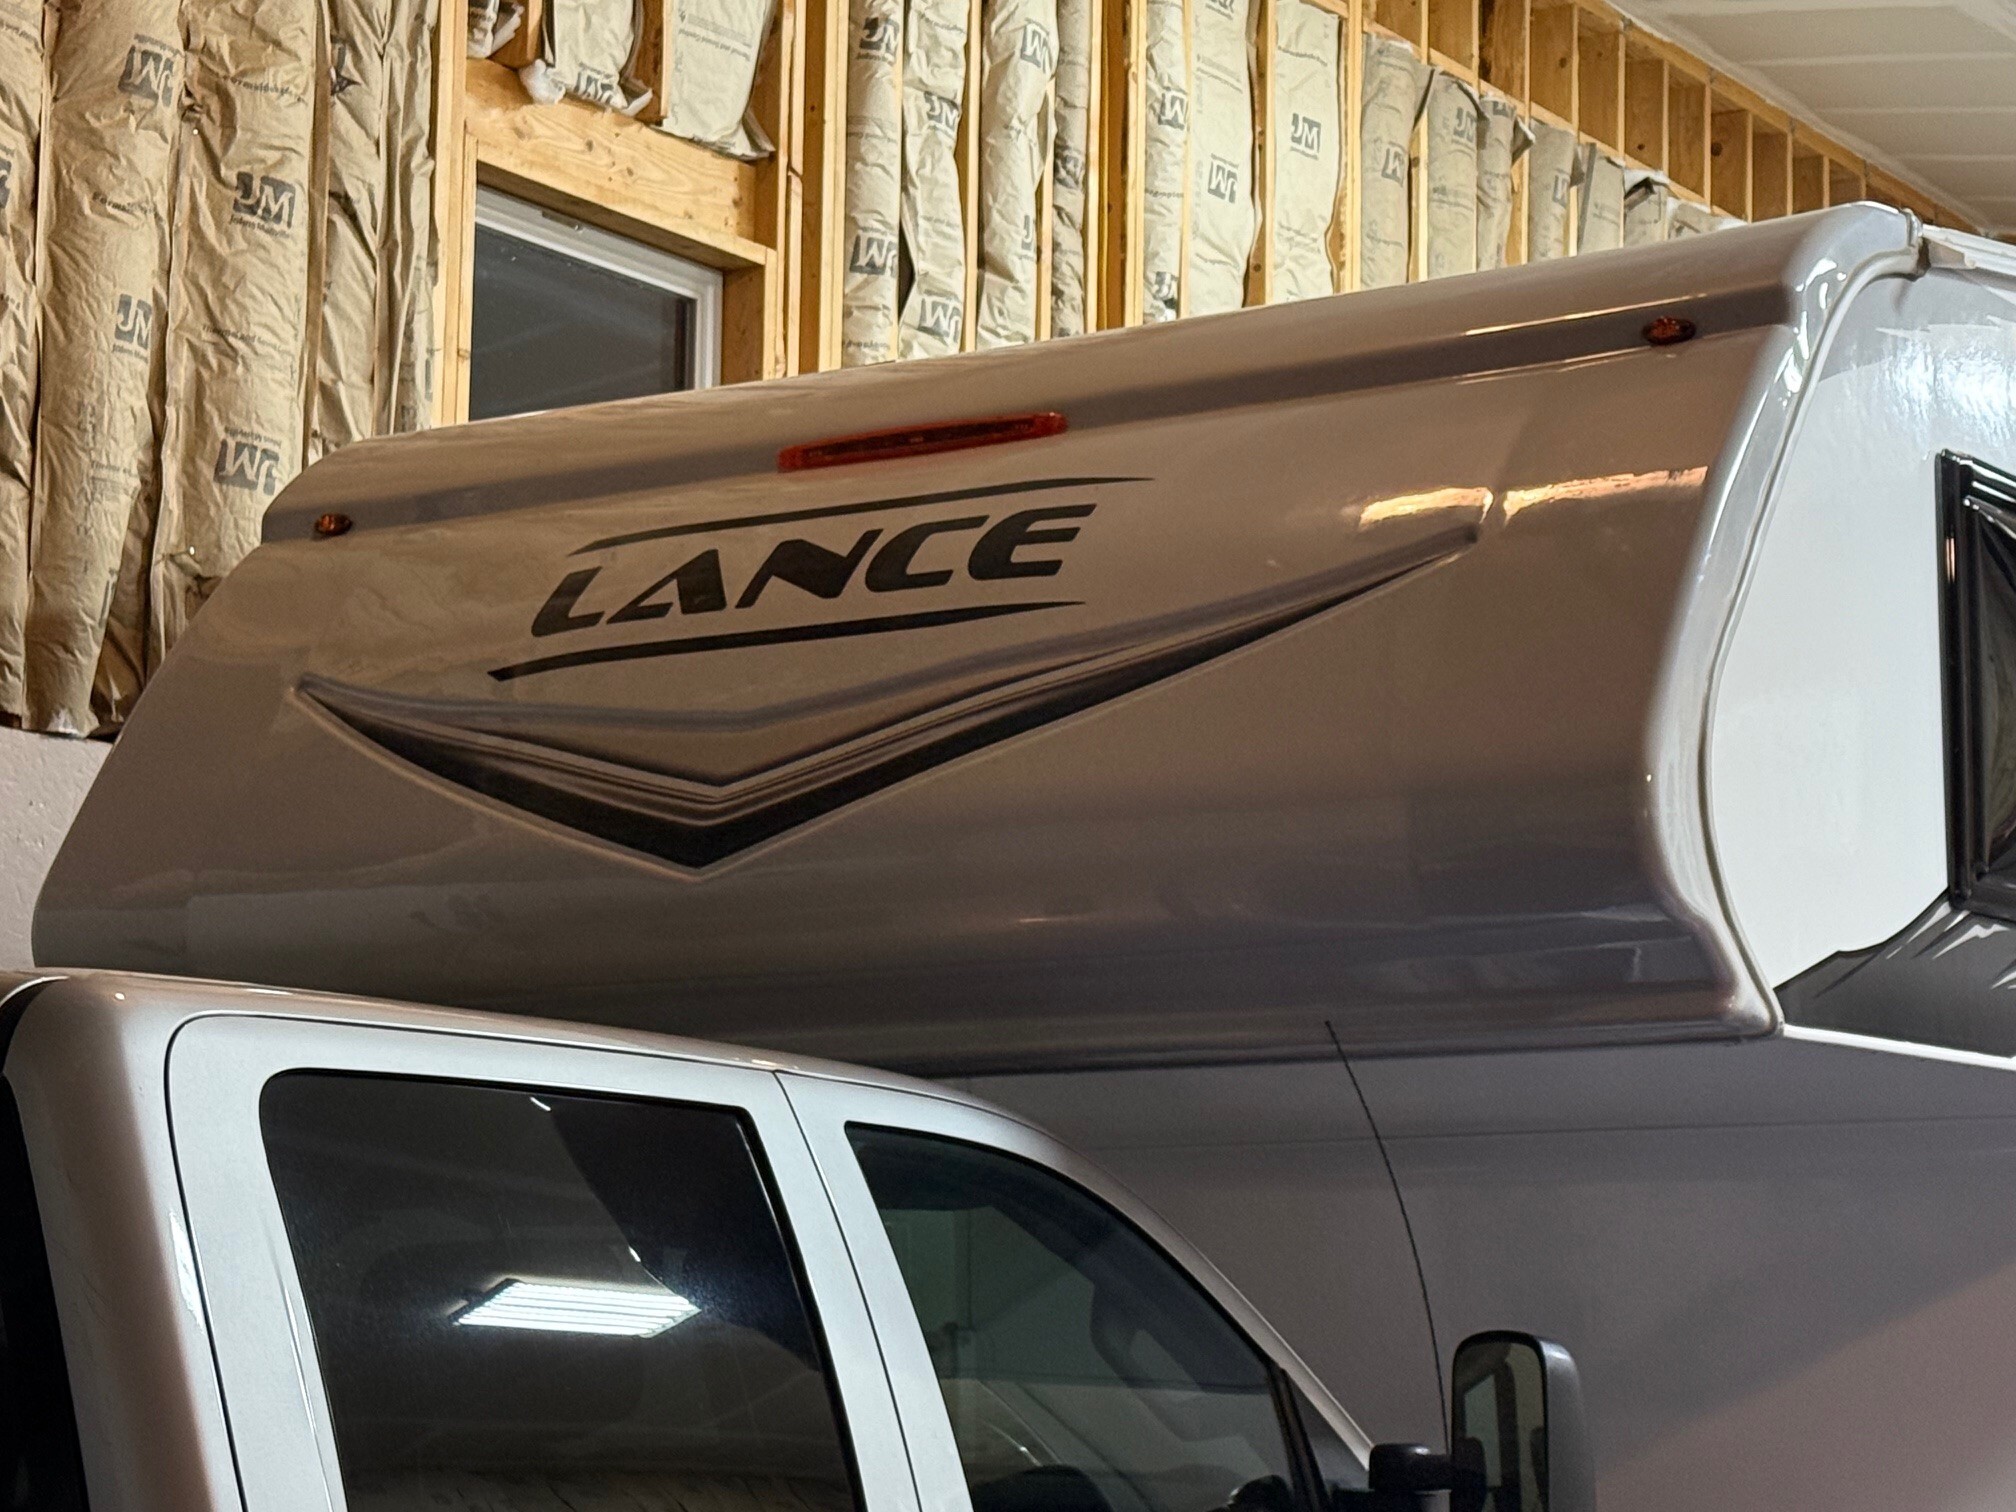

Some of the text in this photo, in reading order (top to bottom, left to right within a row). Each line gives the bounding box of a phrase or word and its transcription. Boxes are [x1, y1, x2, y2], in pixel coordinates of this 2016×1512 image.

[118, 44, 174, 107] JM
[1158, 92, 1187, 130] M
[1291, 113, 1321, 154] JM
[233, 171, 295, 229] JM
[1208, 160, 1238, 204] JM
[213, 438, 280, 496] JM
[531, 503, 1097, 638] LANCE
